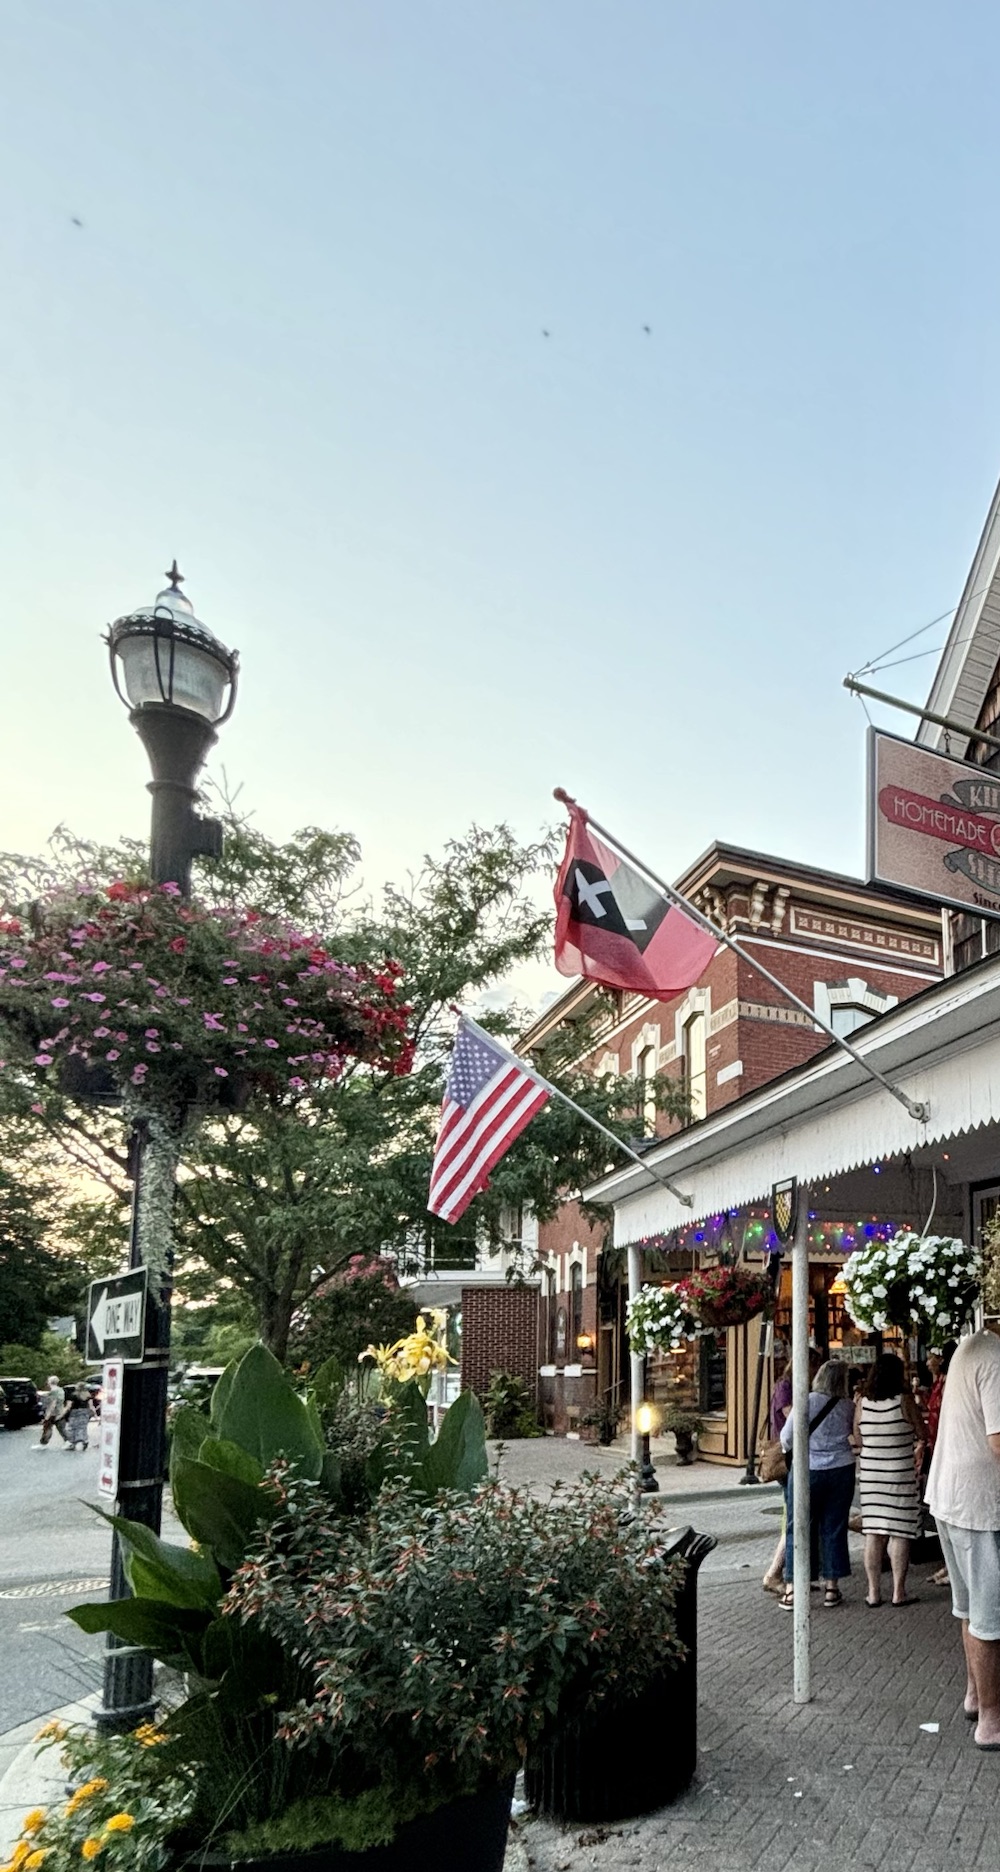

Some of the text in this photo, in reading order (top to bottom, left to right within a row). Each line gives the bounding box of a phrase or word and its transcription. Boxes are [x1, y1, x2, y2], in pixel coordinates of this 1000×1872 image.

[894, 796, 986, 845] HOMEMADE
[106, 1299, 140, 1335] ONE WAY
